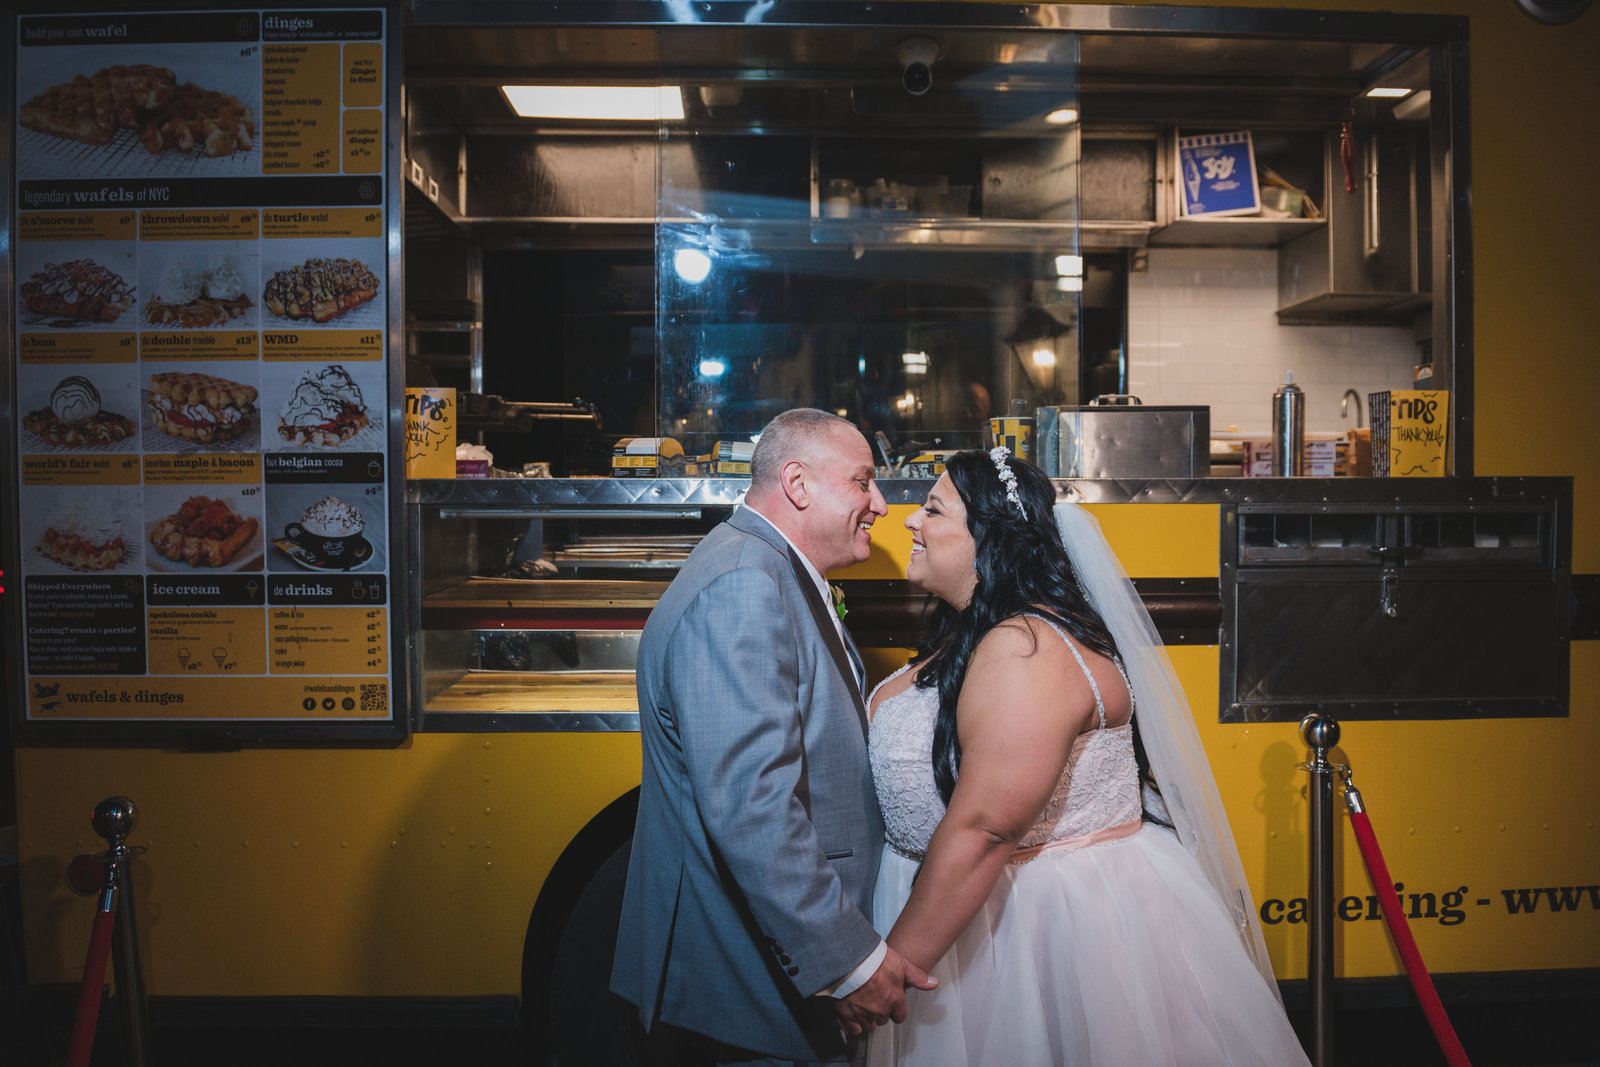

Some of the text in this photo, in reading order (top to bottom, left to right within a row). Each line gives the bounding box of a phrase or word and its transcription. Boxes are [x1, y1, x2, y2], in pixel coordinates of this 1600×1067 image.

[265, 16, 314, 31] dinges
[26, 24, 128, 40] build your own wafel
[350, 67, 376, 75] dinges
[25, 187, 170, 206] legendary wafels of NYC
[30, 215, 76, 225] s'mores
[77, 215, 95, 225] wafel
[142, 213, 230, 223] throwdown wafel
[264, 212, 329, 222] de turtle wafel
[31, 336, 56, 346] bom
[141, 335, 215, 345] de double trouble
[264, 334, 298, 344] WMD
[1391, 398, 1438, 424] TIPS
[24, 458, 111, 468] world's fair wafel
[145, 457, 255, 469] bourbon maple & bacon
[266, 456, 344, 469] hot belgian cocoa
[28, 583, 112, 592] Shipped Everywhere
[153, 583, 221, 595] ice cream
[273, 584, 333, 596] de drinks
[149, 610, 218, 619] spekuloos cookie
[29, 626, 69, 635] Catering?
[70, 626, 97, 635] events
[104, 626, 137, 635] parties?
[149, 627, 178, 635] vanilla
[275, 647, 288, 655] coke
[275, 659, 306, 669] orange juice
[303, 684, 356, 694] @wafelsanddinges
[66, 690, 185, 706] wafels & dinges
[1260, 882, 1467, 926] caering
